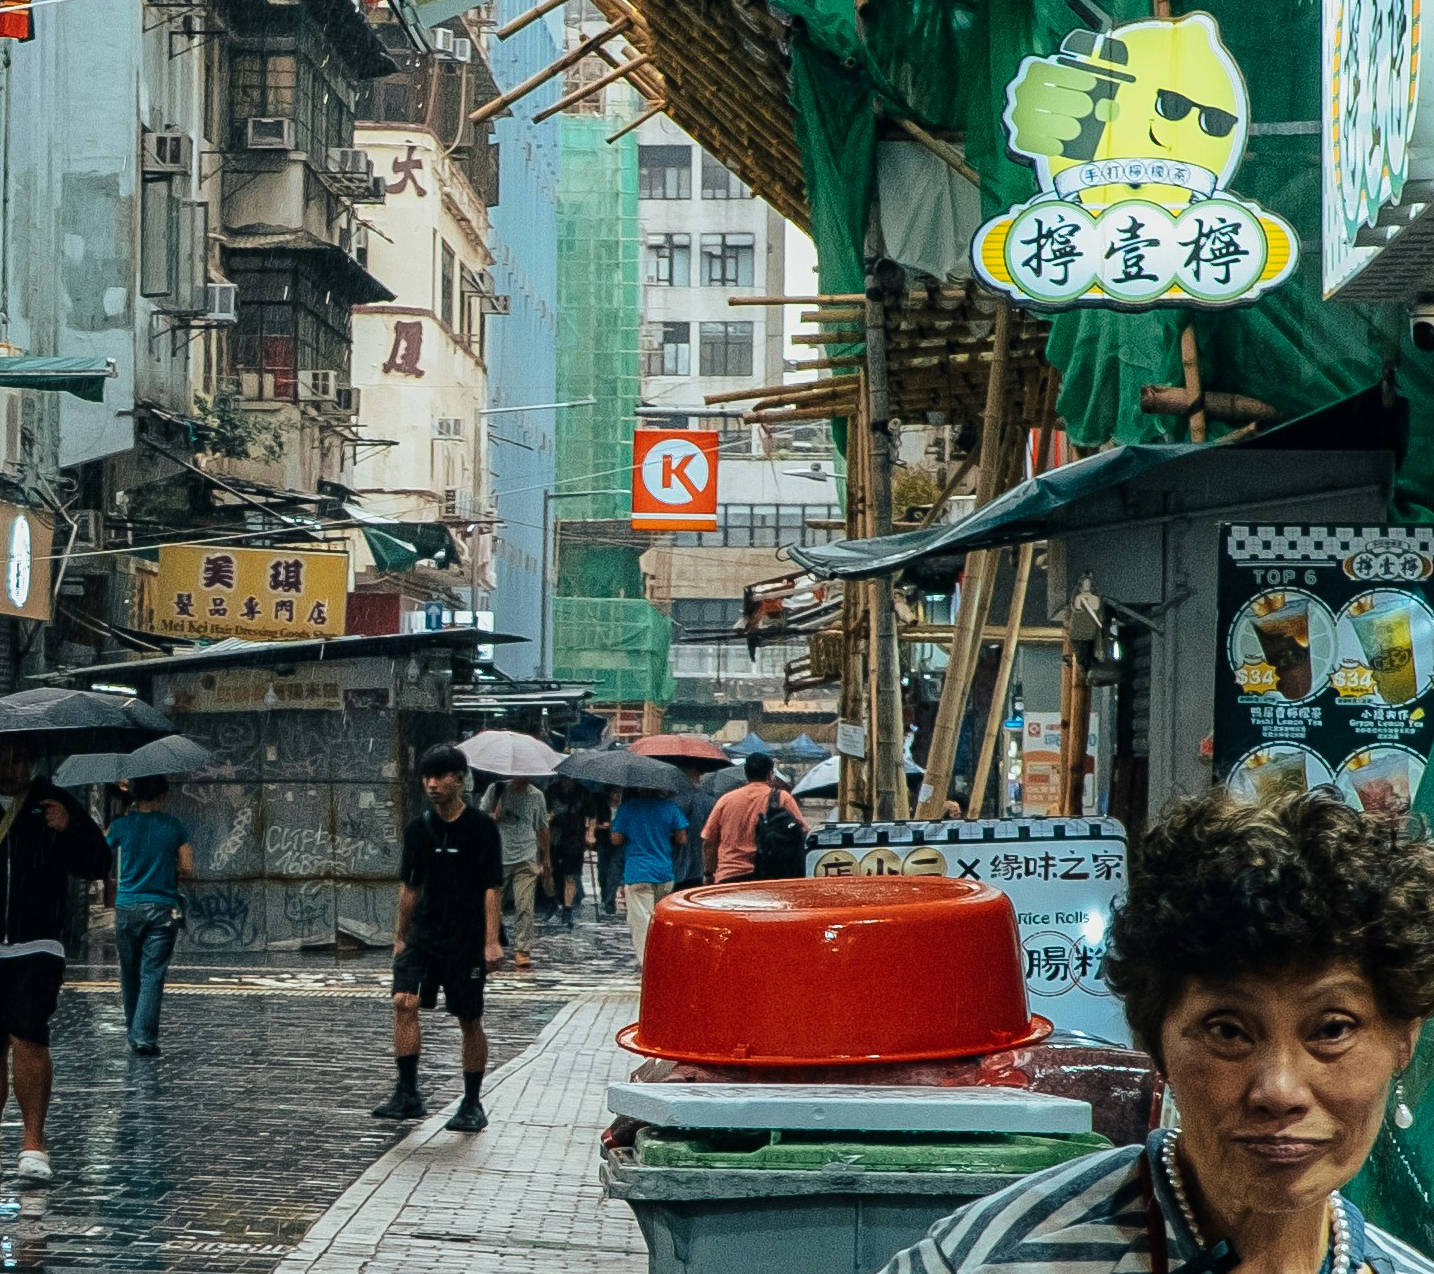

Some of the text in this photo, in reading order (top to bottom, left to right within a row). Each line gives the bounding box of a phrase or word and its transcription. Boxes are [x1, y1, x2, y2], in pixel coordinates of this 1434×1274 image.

[662, 454, 694, 490] K
[1253, 568, 1318, 586] TOP 6
[160, 618, 185, 632] Mei
[211, 623, 234, 635] Hair
[990, 849, 1125, 882] 緣味之家
[1018, 911, 1090, 926] Rice Rolls
